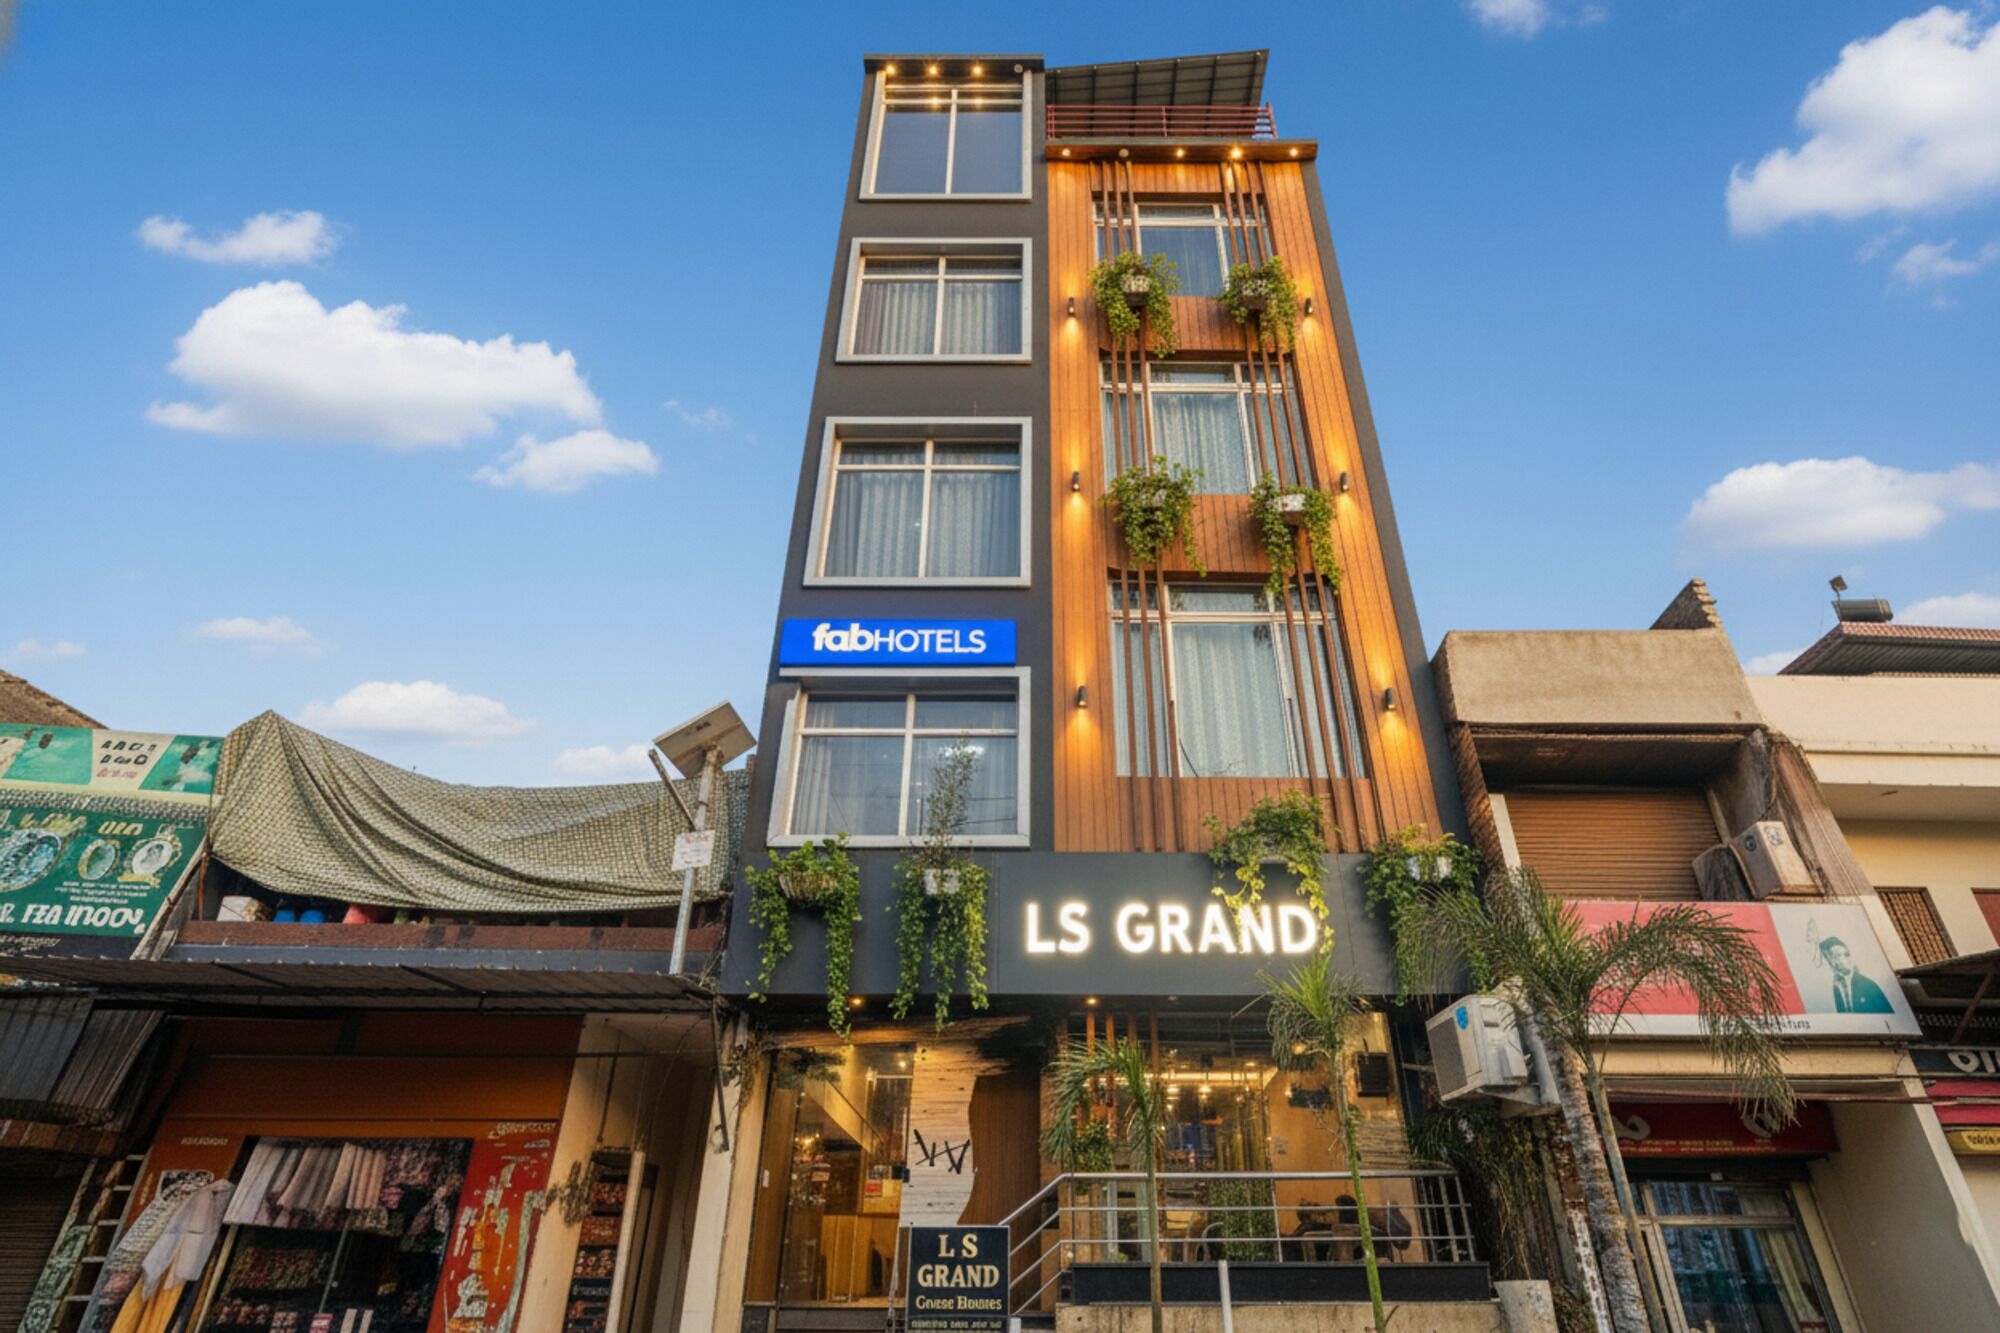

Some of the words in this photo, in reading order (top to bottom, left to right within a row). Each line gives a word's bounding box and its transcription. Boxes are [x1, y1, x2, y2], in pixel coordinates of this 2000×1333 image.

[812, 622, 987, 654] fabHOTELS
[1026, 902, 1091, 954] LS
[1115, 902, 1318, 954] GRAND
[917, 1263, 1000, 1288] GRAND
